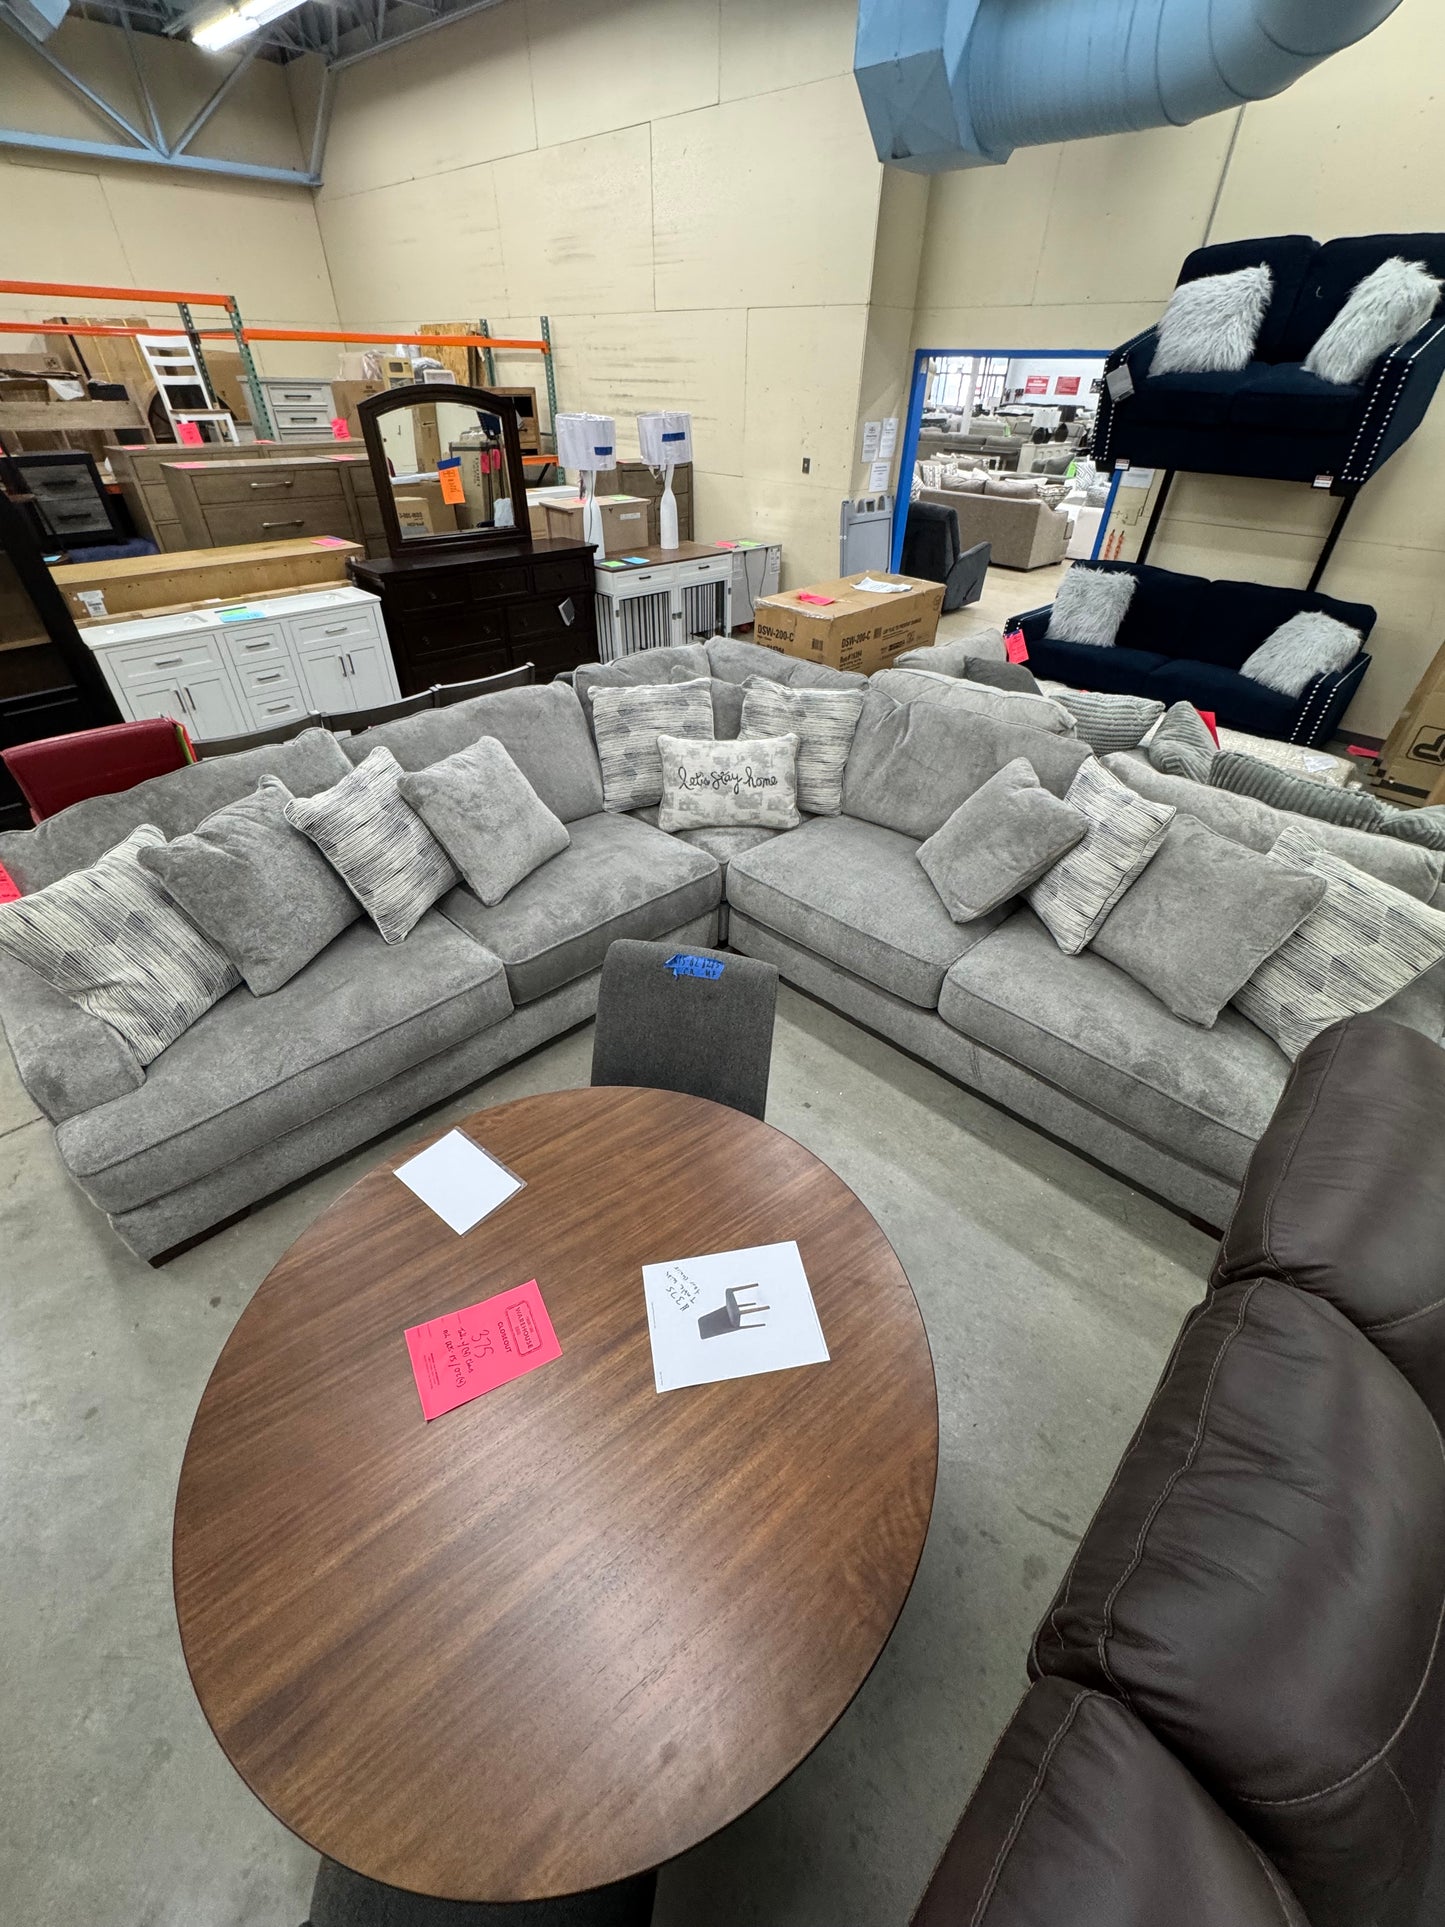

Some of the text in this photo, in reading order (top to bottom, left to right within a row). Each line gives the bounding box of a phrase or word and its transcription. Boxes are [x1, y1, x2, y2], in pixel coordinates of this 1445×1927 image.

[757, 624, 795, 642] DSW-200-C
[841, 630, 872, 649] DSW-200-C
[743, 766, 778, 788] home
[497, 1321, 513, 1353] CLOSEOUT
[515, 1306, 533, 1349] WAREHOUSE
[471, 1329, 494, 1359] 375
